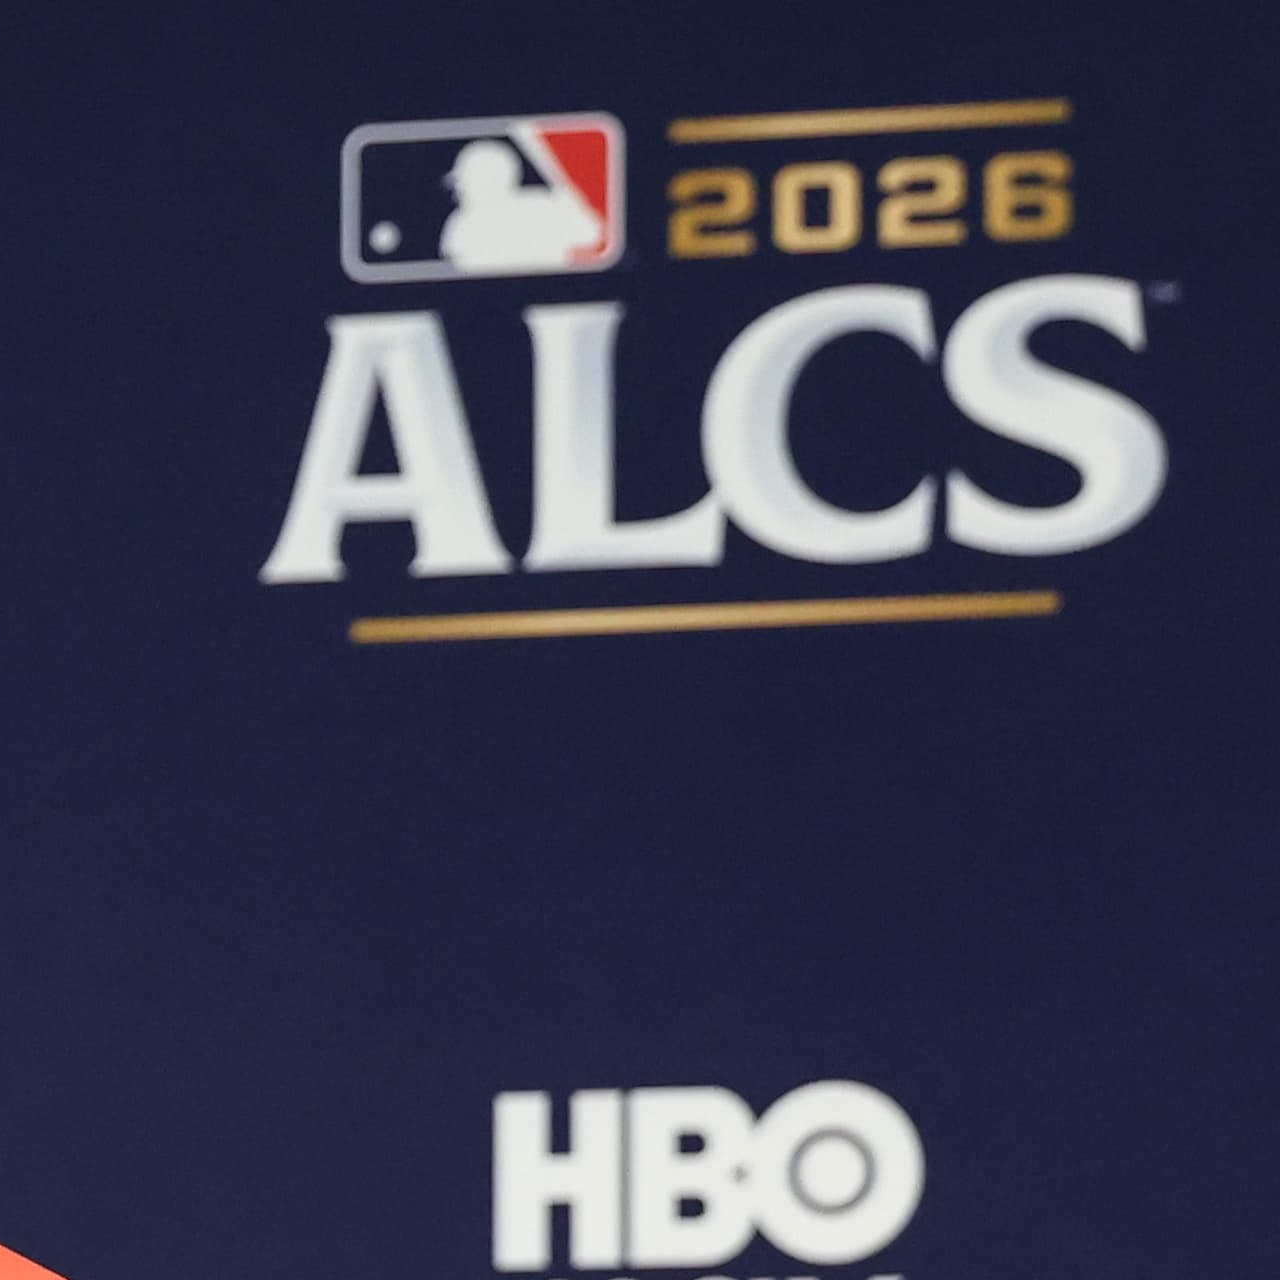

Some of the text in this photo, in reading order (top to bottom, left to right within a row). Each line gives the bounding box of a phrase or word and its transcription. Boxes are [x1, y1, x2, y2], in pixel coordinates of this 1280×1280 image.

[668, 150, 1074, 259] 2026
[259, 273, 1169, 583] ALCS
[492, 1079, 926, 1272] HBO
